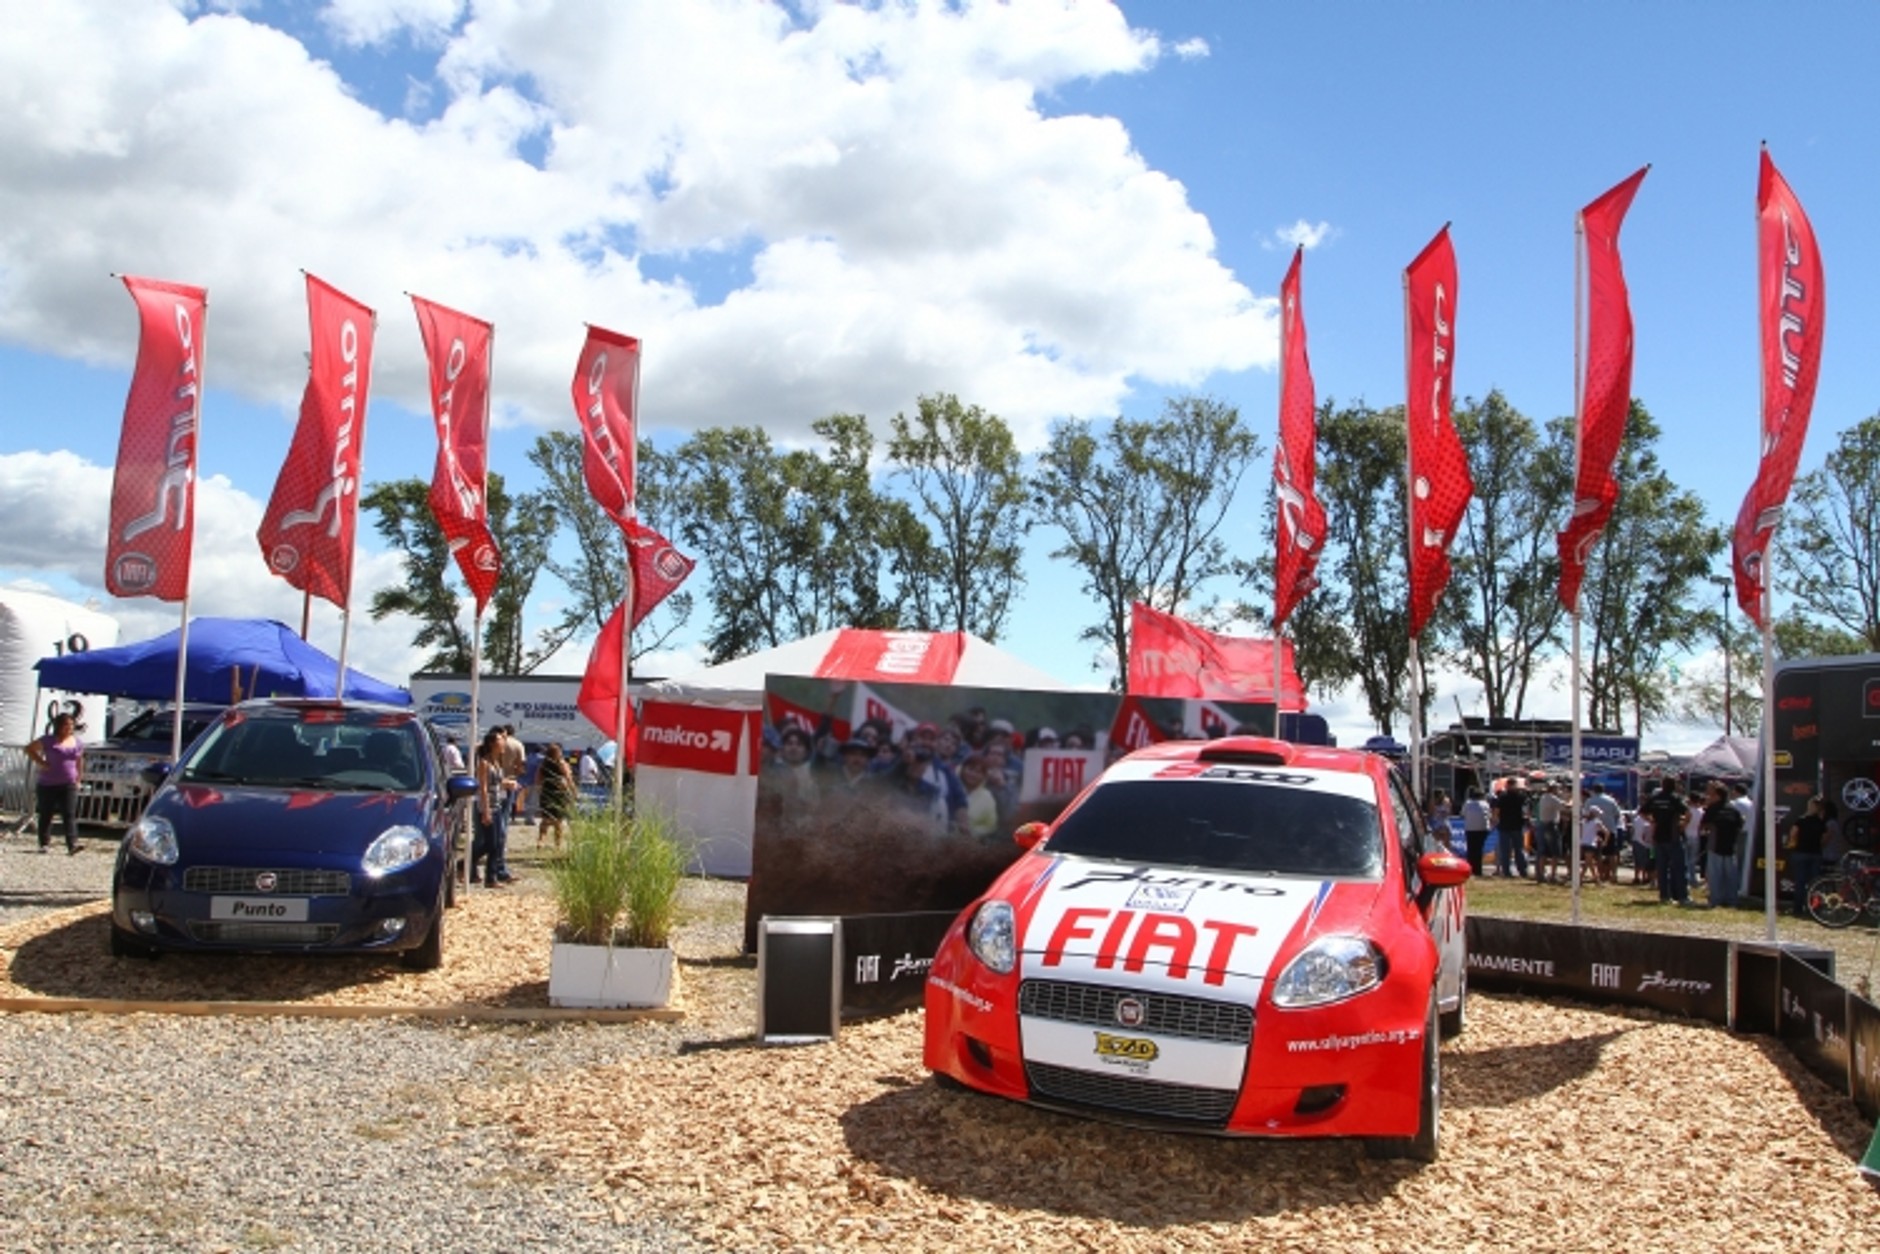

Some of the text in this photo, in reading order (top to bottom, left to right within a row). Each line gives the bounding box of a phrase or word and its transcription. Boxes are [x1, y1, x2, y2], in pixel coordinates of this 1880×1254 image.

[643, 725, 709, 749] makro
[1558, 744, 1636, 759] SBARU
[1041, 757, 1088, 795] FIAT
[232, 901, 288, 917] Punto
[1041, 907, 1260, 987] FIAT
[855, 954, 881, 984] FIAT
[1591, 962, 1622, 988] FIAT
